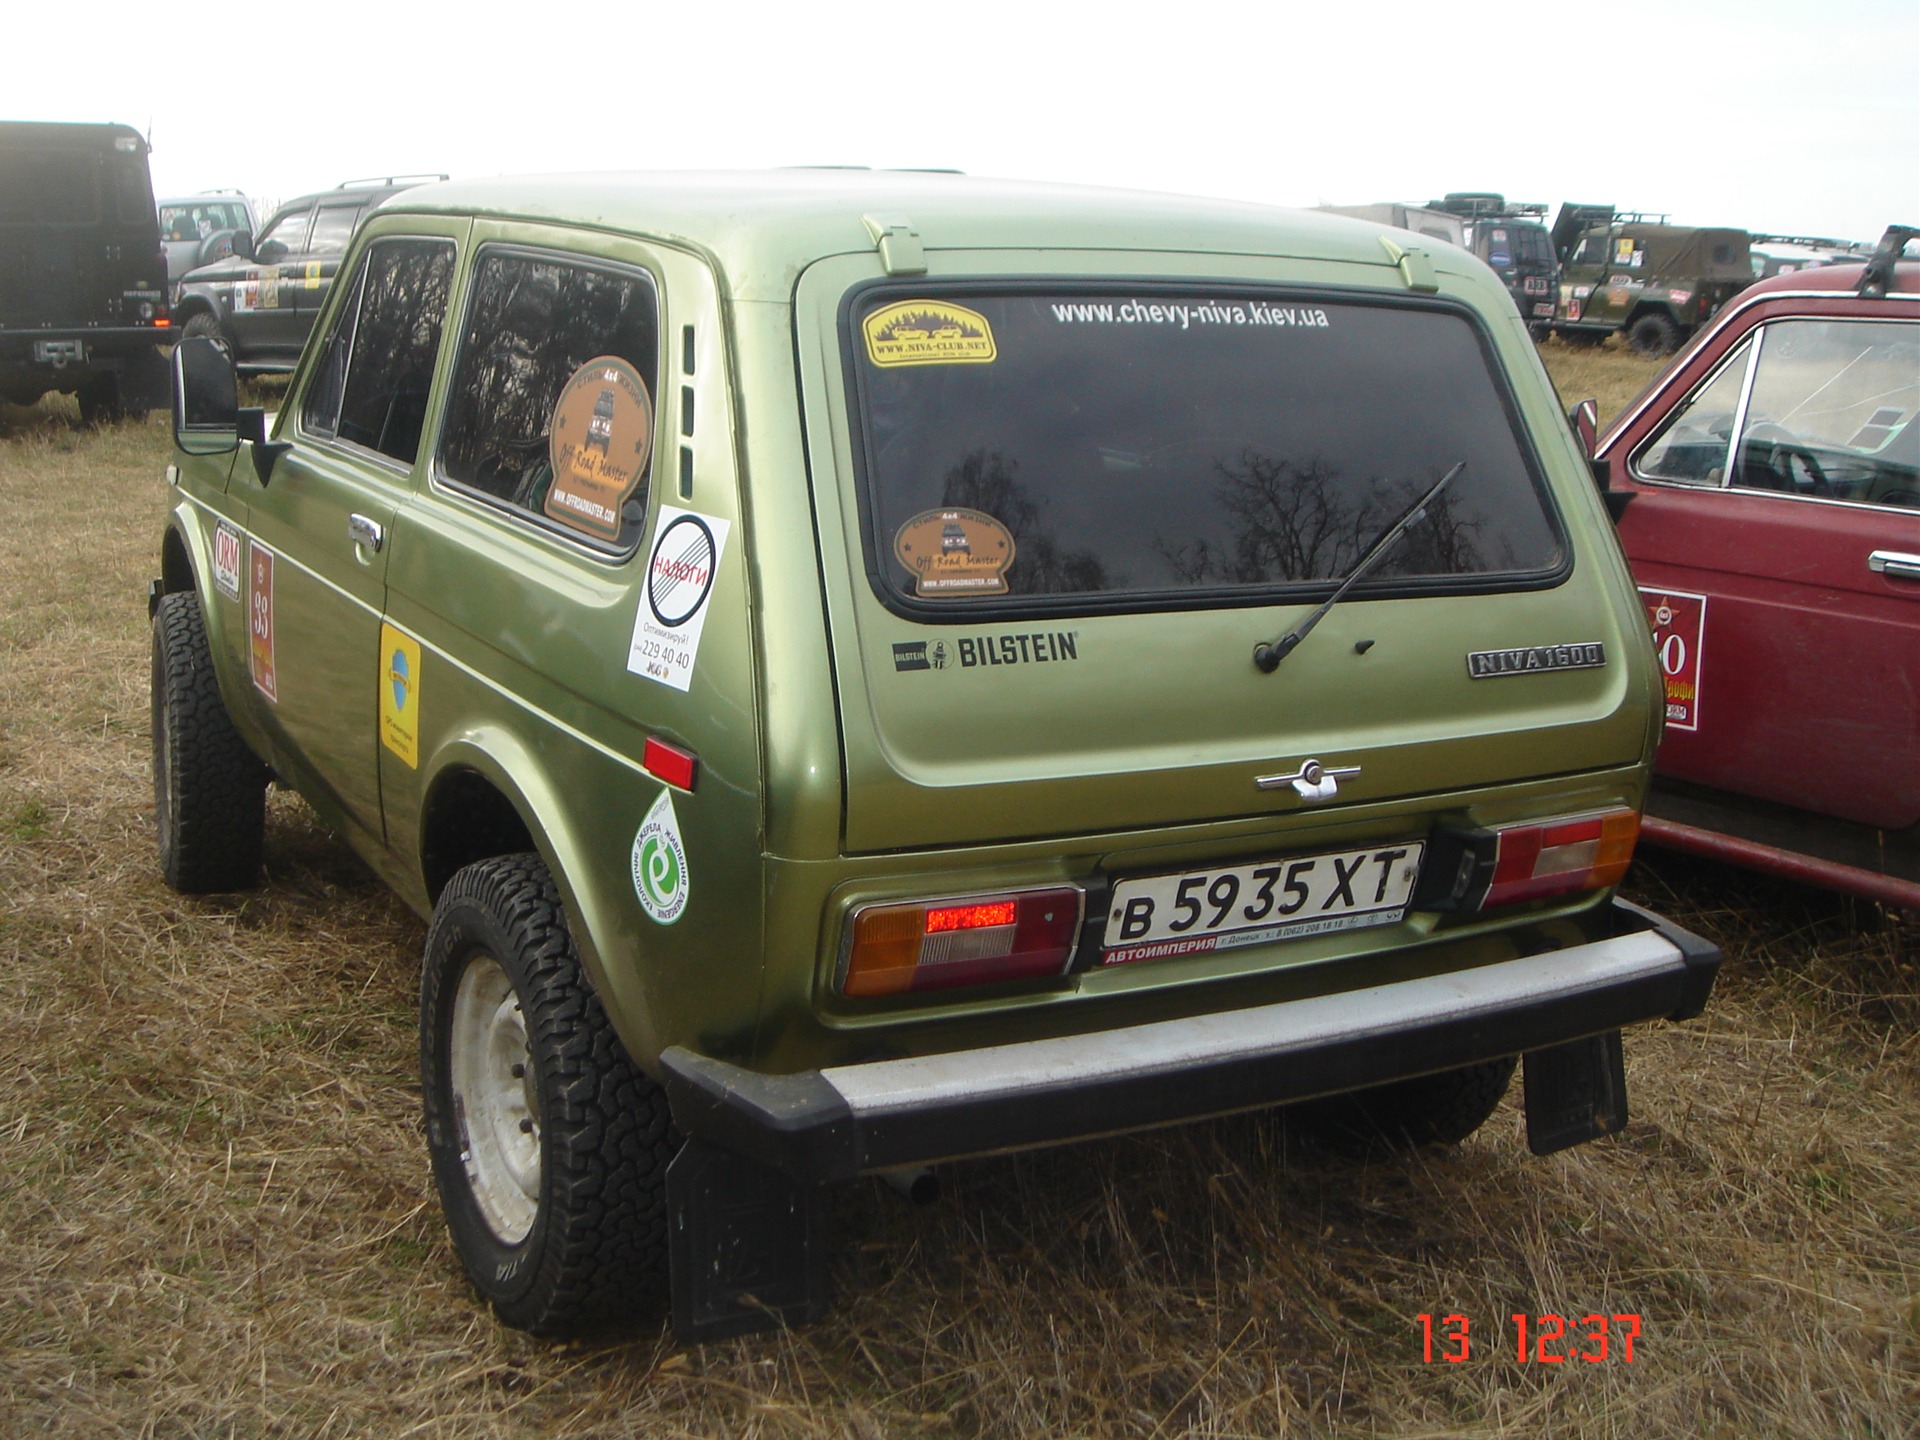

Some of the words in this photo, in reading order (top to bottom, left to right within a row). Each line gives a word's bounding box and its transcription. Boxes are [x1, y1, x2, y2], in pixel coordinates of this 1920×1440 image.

[1051, 299, 1329, 330] www.chevy-niva.kiev.ua
[876, 341, 987, 355] WWW.NIVA-CLUB.NET
[654, 556, 708, 587] НАЛОГИ
[254, 590, 269, 640] 33
[642, 639, 660, 659] 229
[661, 646, 675, 664] 40
[676, 652, 690, 669] 40
[895, 651, 926, 663] BILSTEIN
[958, 632, 1078, 667] BILSTEIN
[1476, 650, 1542, 673] NIVA
[1545, 645, 1599, 667] 1600
[1169, 861, 1316, 932] 5935
[1105, 936, 1218, 964] АВТОИМПЕРИЯ
